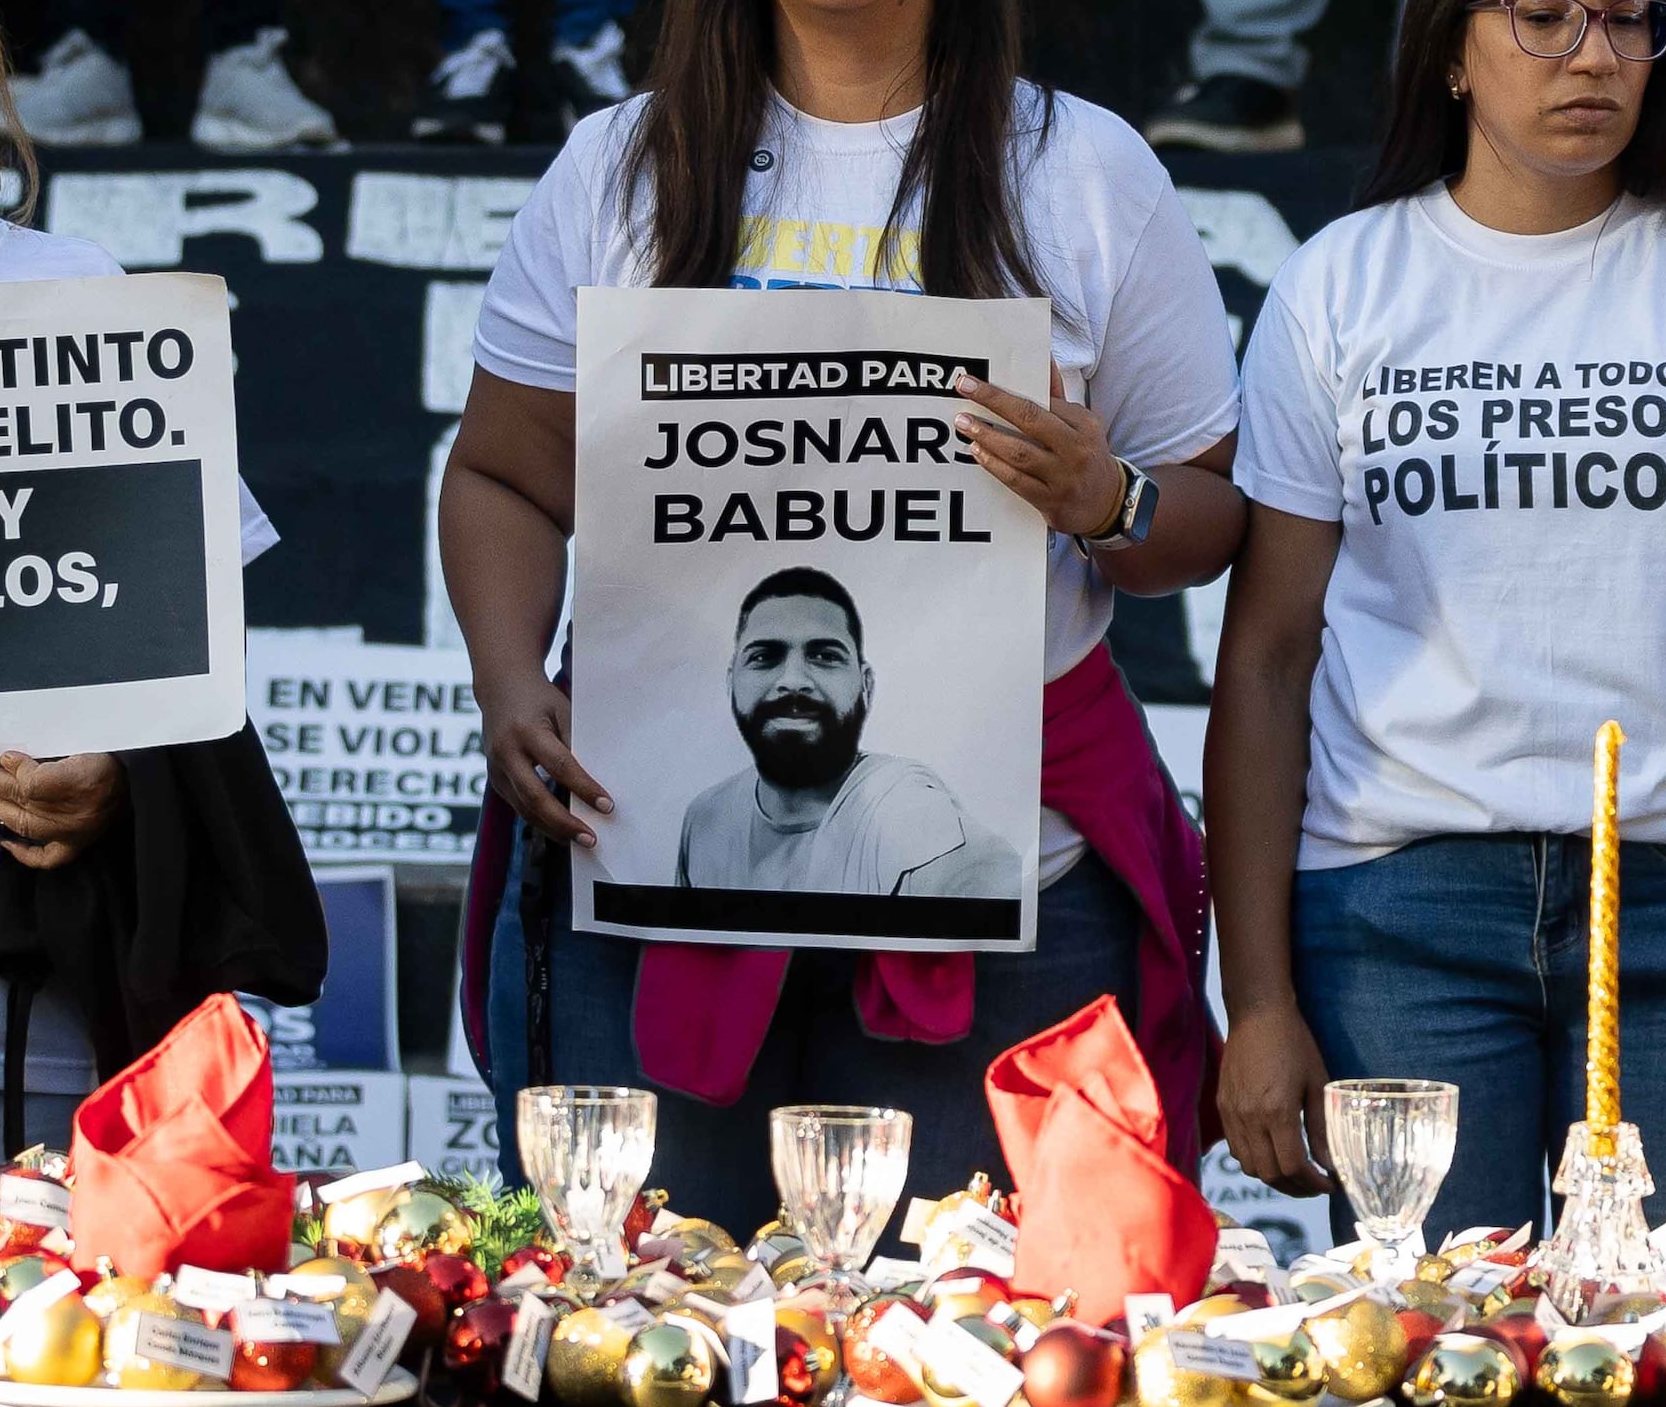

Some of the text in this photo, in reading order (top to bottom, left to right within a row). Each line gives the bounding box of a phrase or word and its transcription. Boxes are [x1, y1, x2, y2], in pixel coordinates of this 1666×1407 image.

[645, 359, 973, 393] LIBERTAD PARA
[1363, 360, 1520, 399] LIBEREN
[1533, 362, 1562, 390] A
[1363, 400, 1460, 454] LOS
[651, 488, 994, 544] BABUEL
[266, 678, 330, 710] EN
[265, 722, 325, 754] SE
[293, 804, 453, 831] EBIDO
